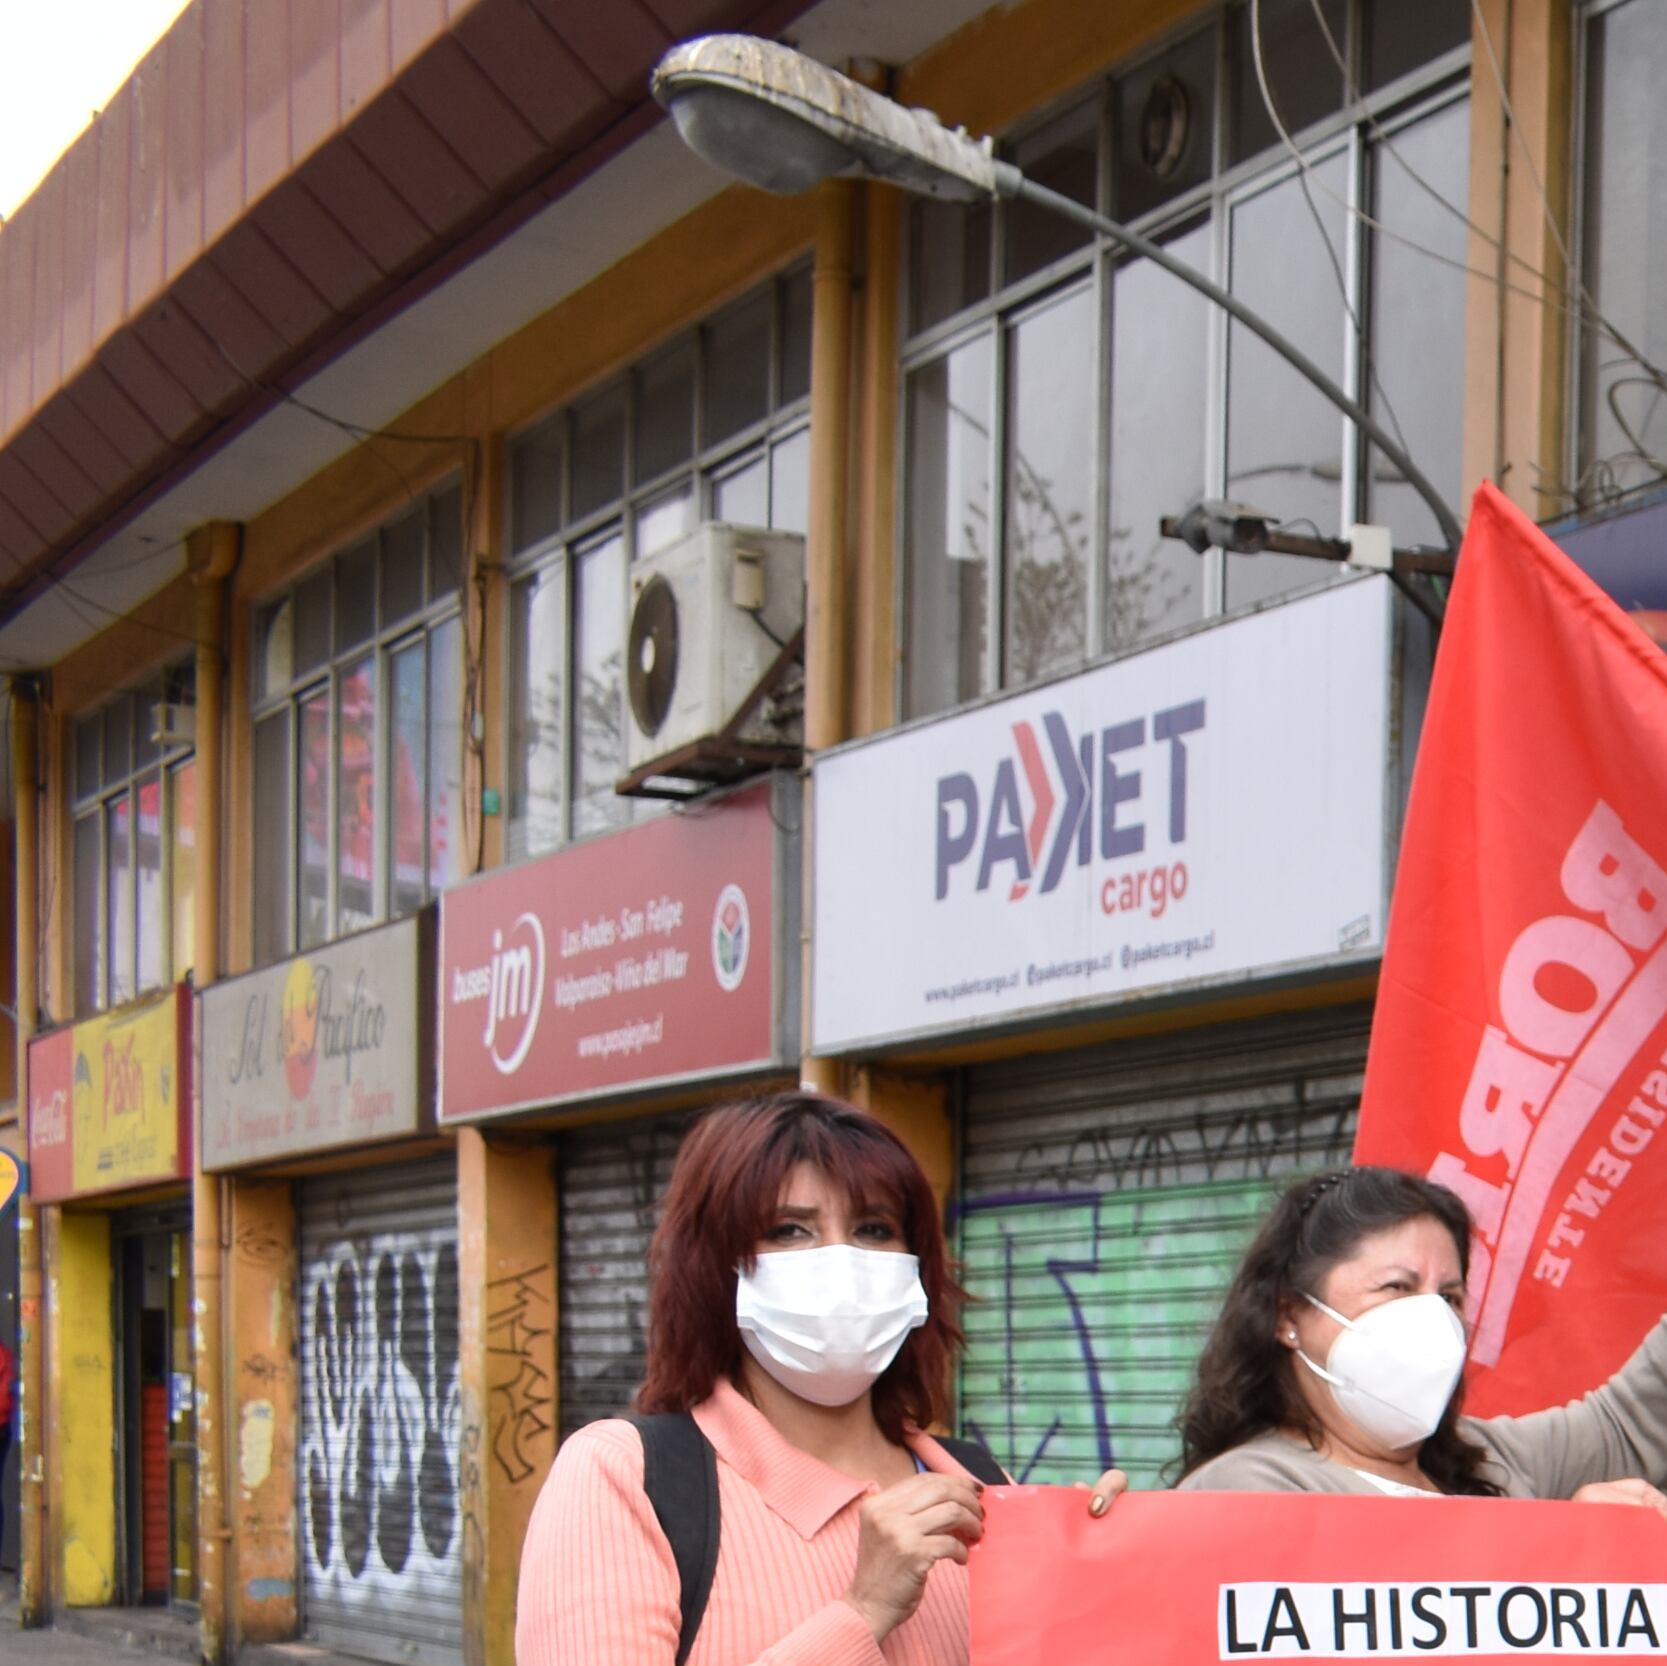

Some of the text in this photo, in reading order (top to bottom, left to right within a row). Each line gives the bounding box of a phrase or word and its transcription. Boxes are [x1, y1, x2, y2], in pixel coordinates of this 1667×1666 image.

[1102, 862, 1189, 919] cargo
[560, 925, 580, 958] Los
[582, 915, 616, 953] Andes
[453, 965, 491, 1004] buses
[1226, 1585, 1661, 1653] LA HISTORIA
